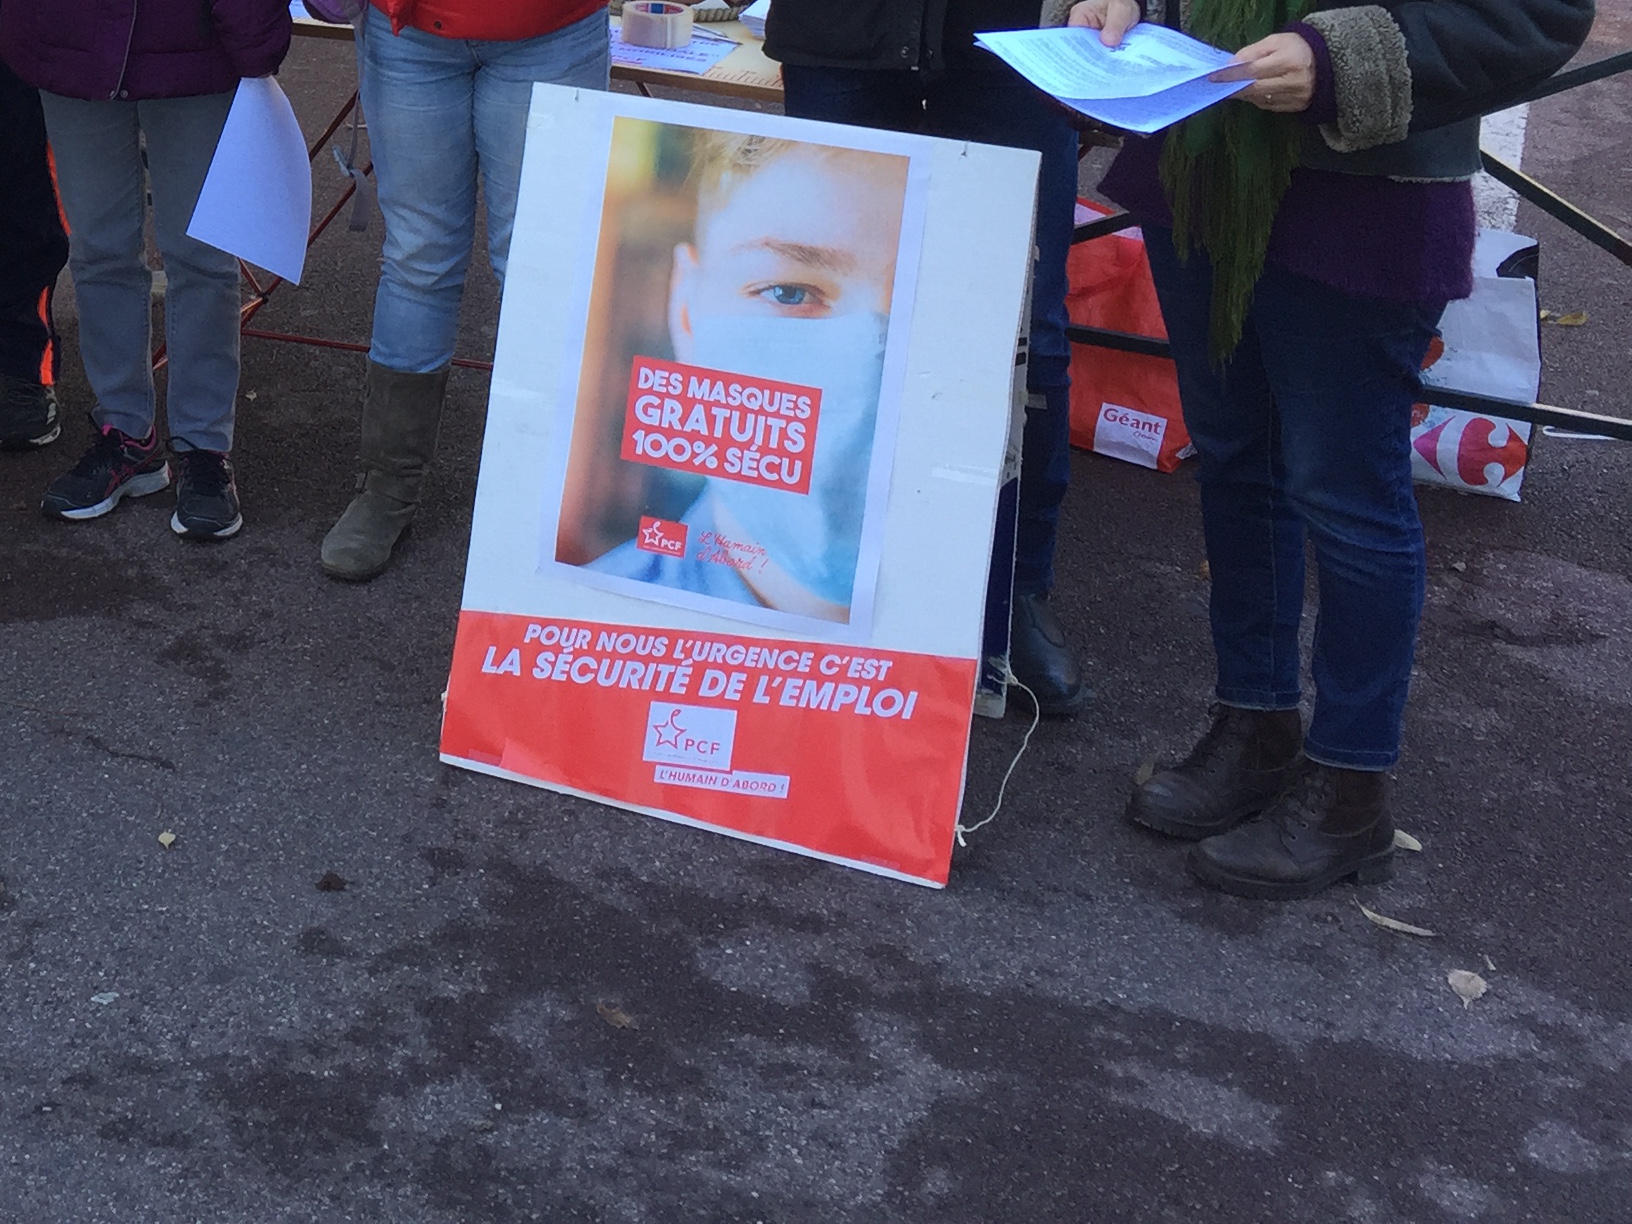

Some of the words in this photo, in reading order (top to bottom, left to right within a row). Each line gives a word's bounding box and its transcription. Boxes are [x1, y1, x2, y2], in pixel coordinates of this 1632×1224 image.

[637, 366, 683, 395] DES
[687, 376, 811, 419] MASQUES
[634, 394, 807, 453] GRATUITS
[1103, 408, 1162, 435] Géant
[632, 429, 718, 469] 100%
[723, 444, 802, 485] SÉCU
[660, 539, 683, 551] PCF
[523, 623, 592, 650] POUR
[596, 631, 669, 657] NOUS
[673, 638, 814, 674] L'URGENCE
[819, 654, 893, 682] C'EST
[481, 645, 521, 676] LA
[532, 645, 693, 695] SÉCURITÉ
[698, 668, 748, 701] DE
[752, 675, 919, 720] L'EMPLOI
[683, 738, 721, 755] PCF
